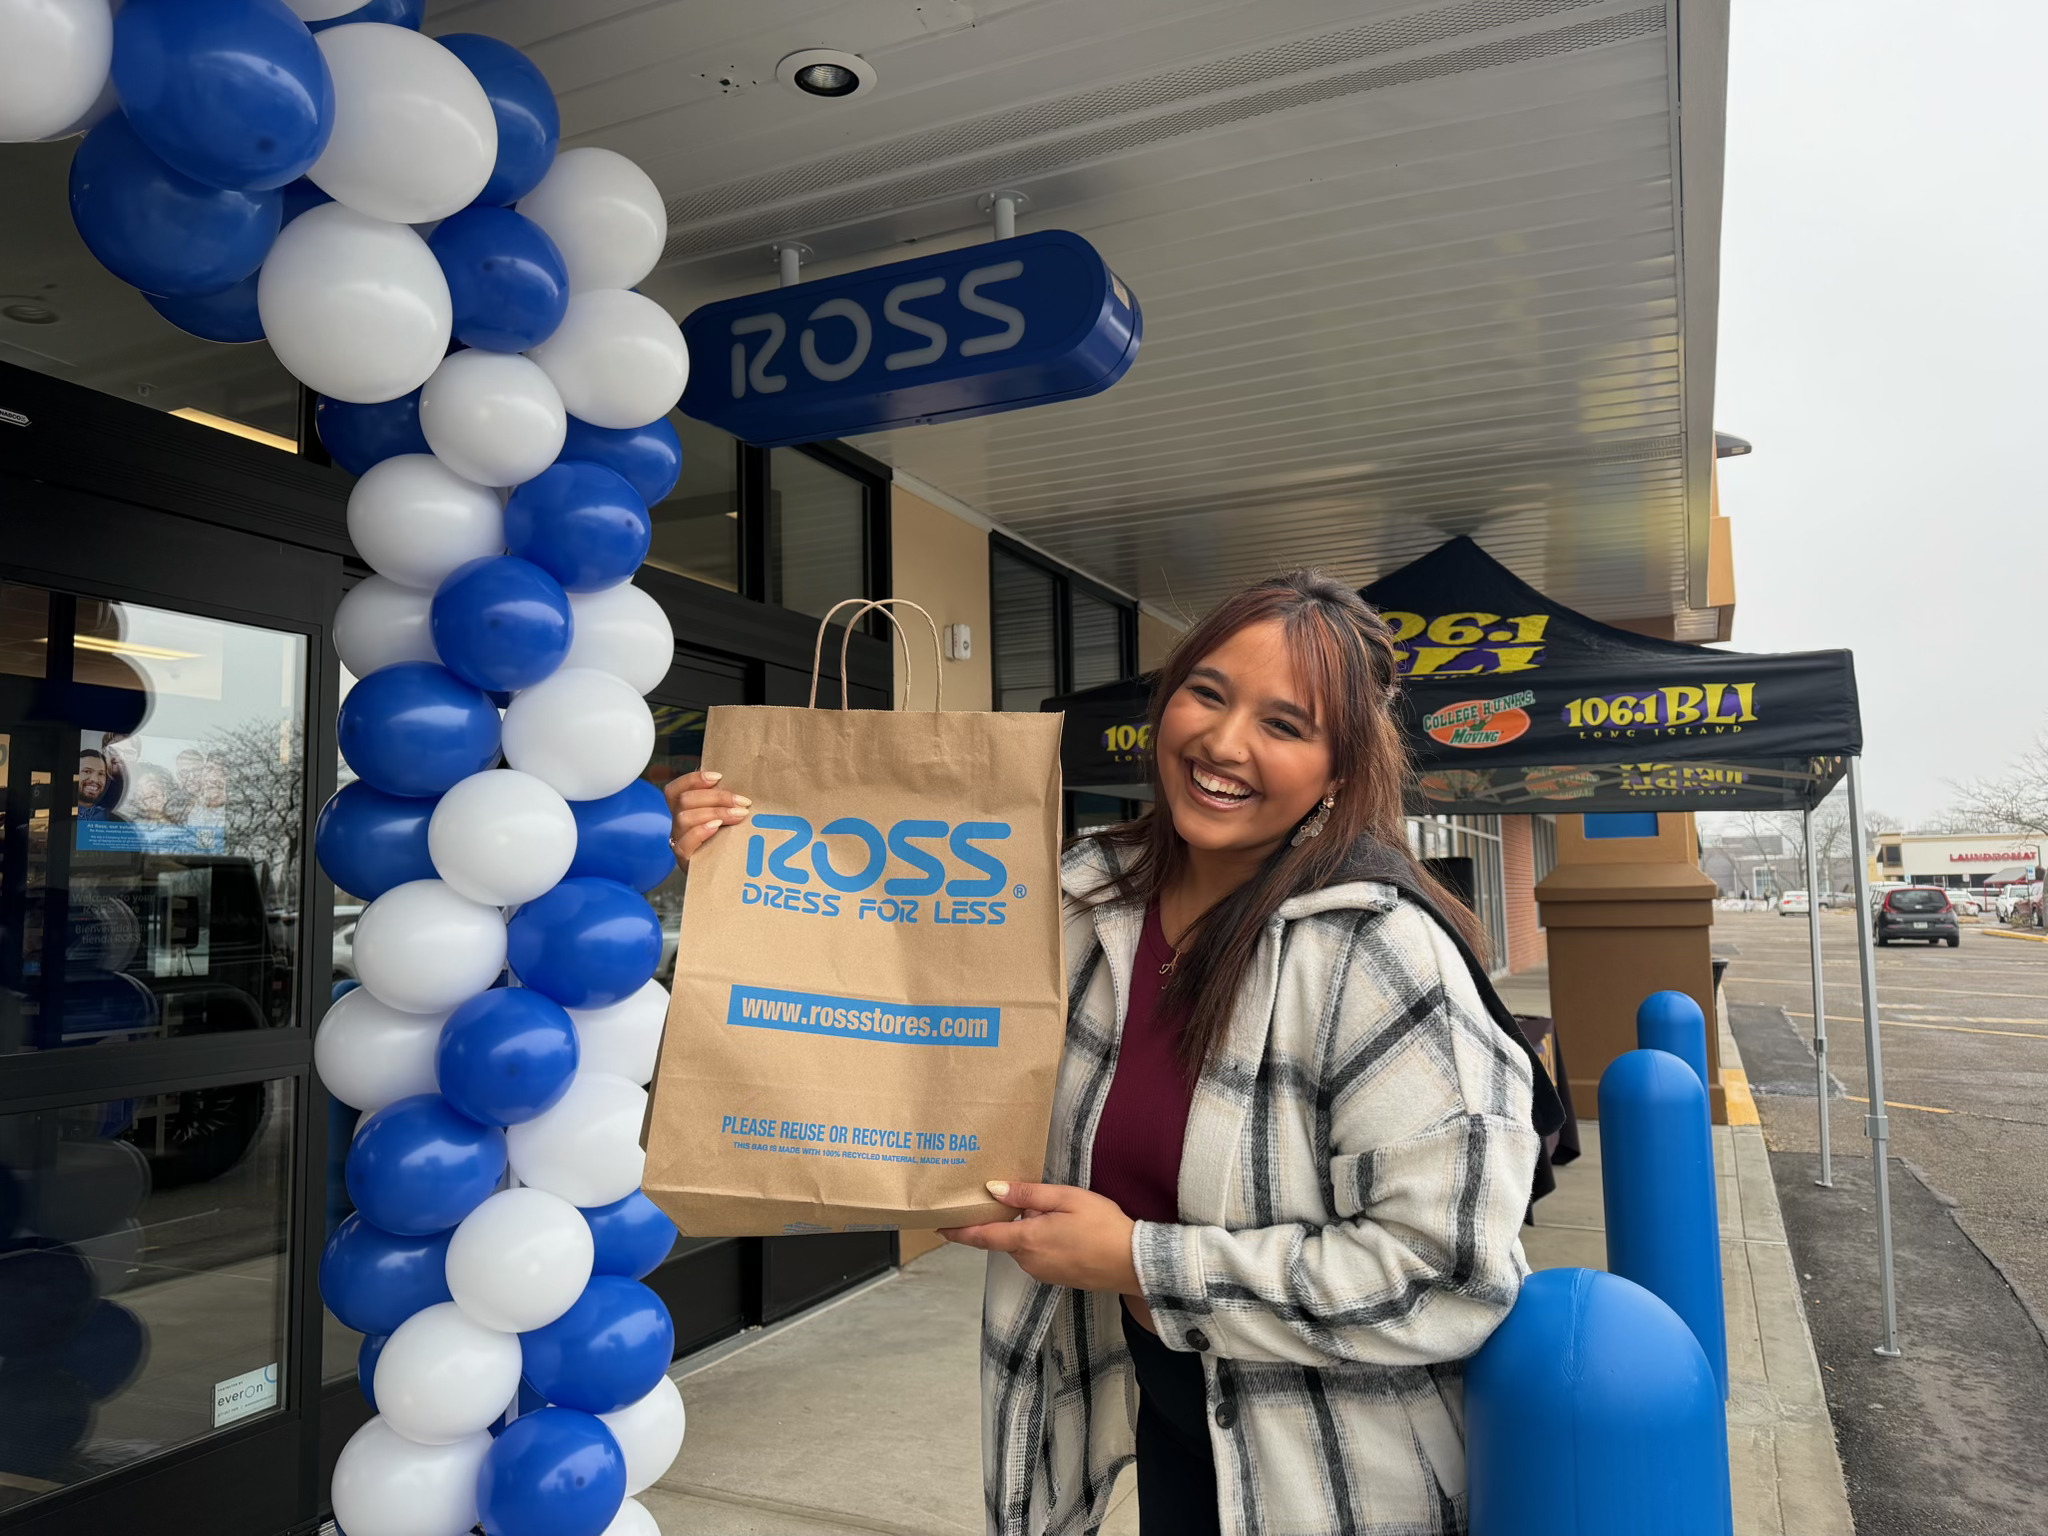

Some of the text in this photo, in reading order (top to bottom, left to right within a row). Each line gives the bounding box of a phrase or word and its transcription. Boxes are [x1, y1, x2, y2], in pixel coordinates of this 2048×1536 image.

[731, 260, 1025, 400] ROSS
[1379, 611, 1550, 645] 06.1
[1423, 705, 1478, 732] COLLEGE
[1565, 682, 1758, 727] 106.1 BLI
[1449, 728, 1499, 744] MOVING
[1579, 725, 1742, 739] LONG ISLAND
[746, 813, 1012, 897] ROSS
[1949, 851, 2036, 863] LAUNDROMAT
[742, 882, 1006, 925] DRESS FOR LESS
[742, 997, 988, 1038] www.rossstores.com
[721, 1115, 981, 1152] PLEASE REUSE OR RECYCLE THIS BAG.
[733, 1141, 750, 1150] THIS
[751, 1143, 768, 1151] BAG
[778, 1145, 800, 1154] MADE
[802, 1147, 820, 1156] WITH
[822, 1149, 841, 1158] 100%
[841, 1150, 880, 1160] RECYCLED
